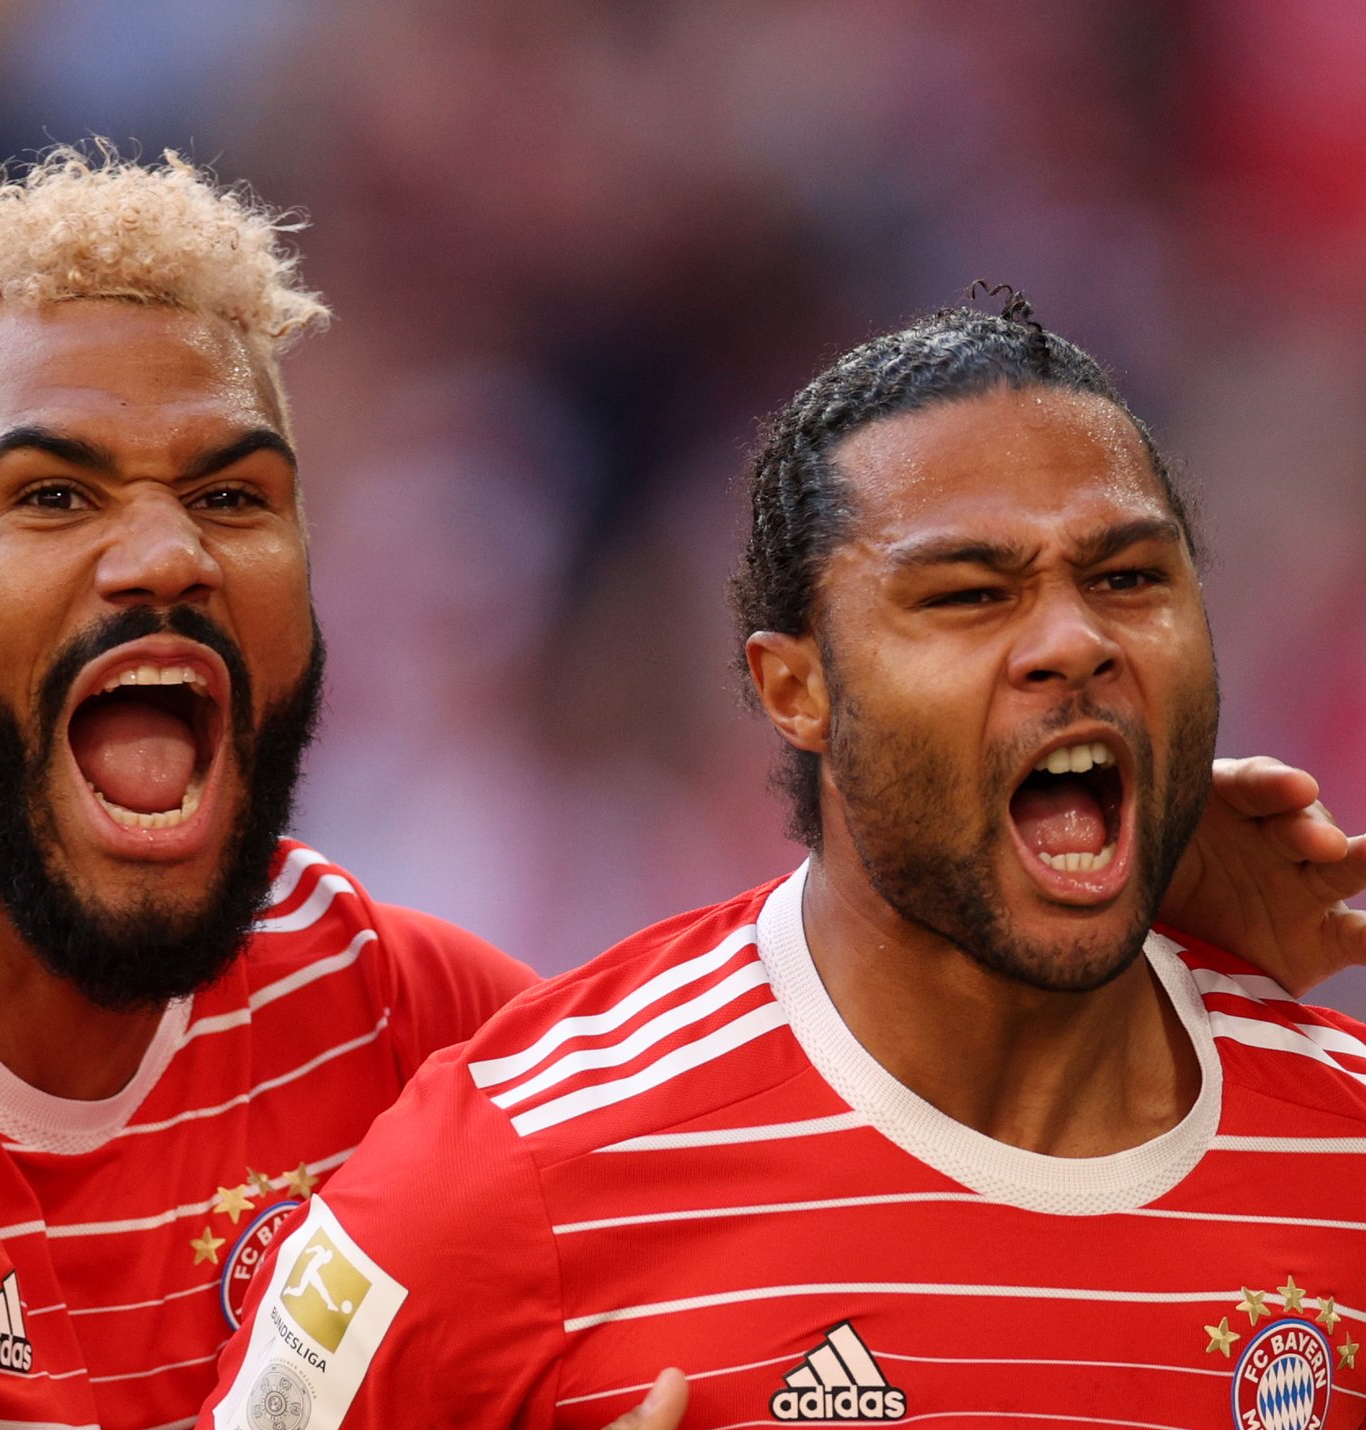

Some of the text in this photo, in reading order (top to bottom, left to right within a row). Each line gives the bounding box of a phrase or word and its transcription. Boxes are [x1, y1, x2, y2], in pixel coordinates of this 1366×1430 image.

[234, 1247, 259, 1280] FC
[270, 1306, 327, 1374] BUNDESLIGA
[1244, 1331, 1327, 1390] FC BAYERN
[772, 1384, 905, 1420] adidas
